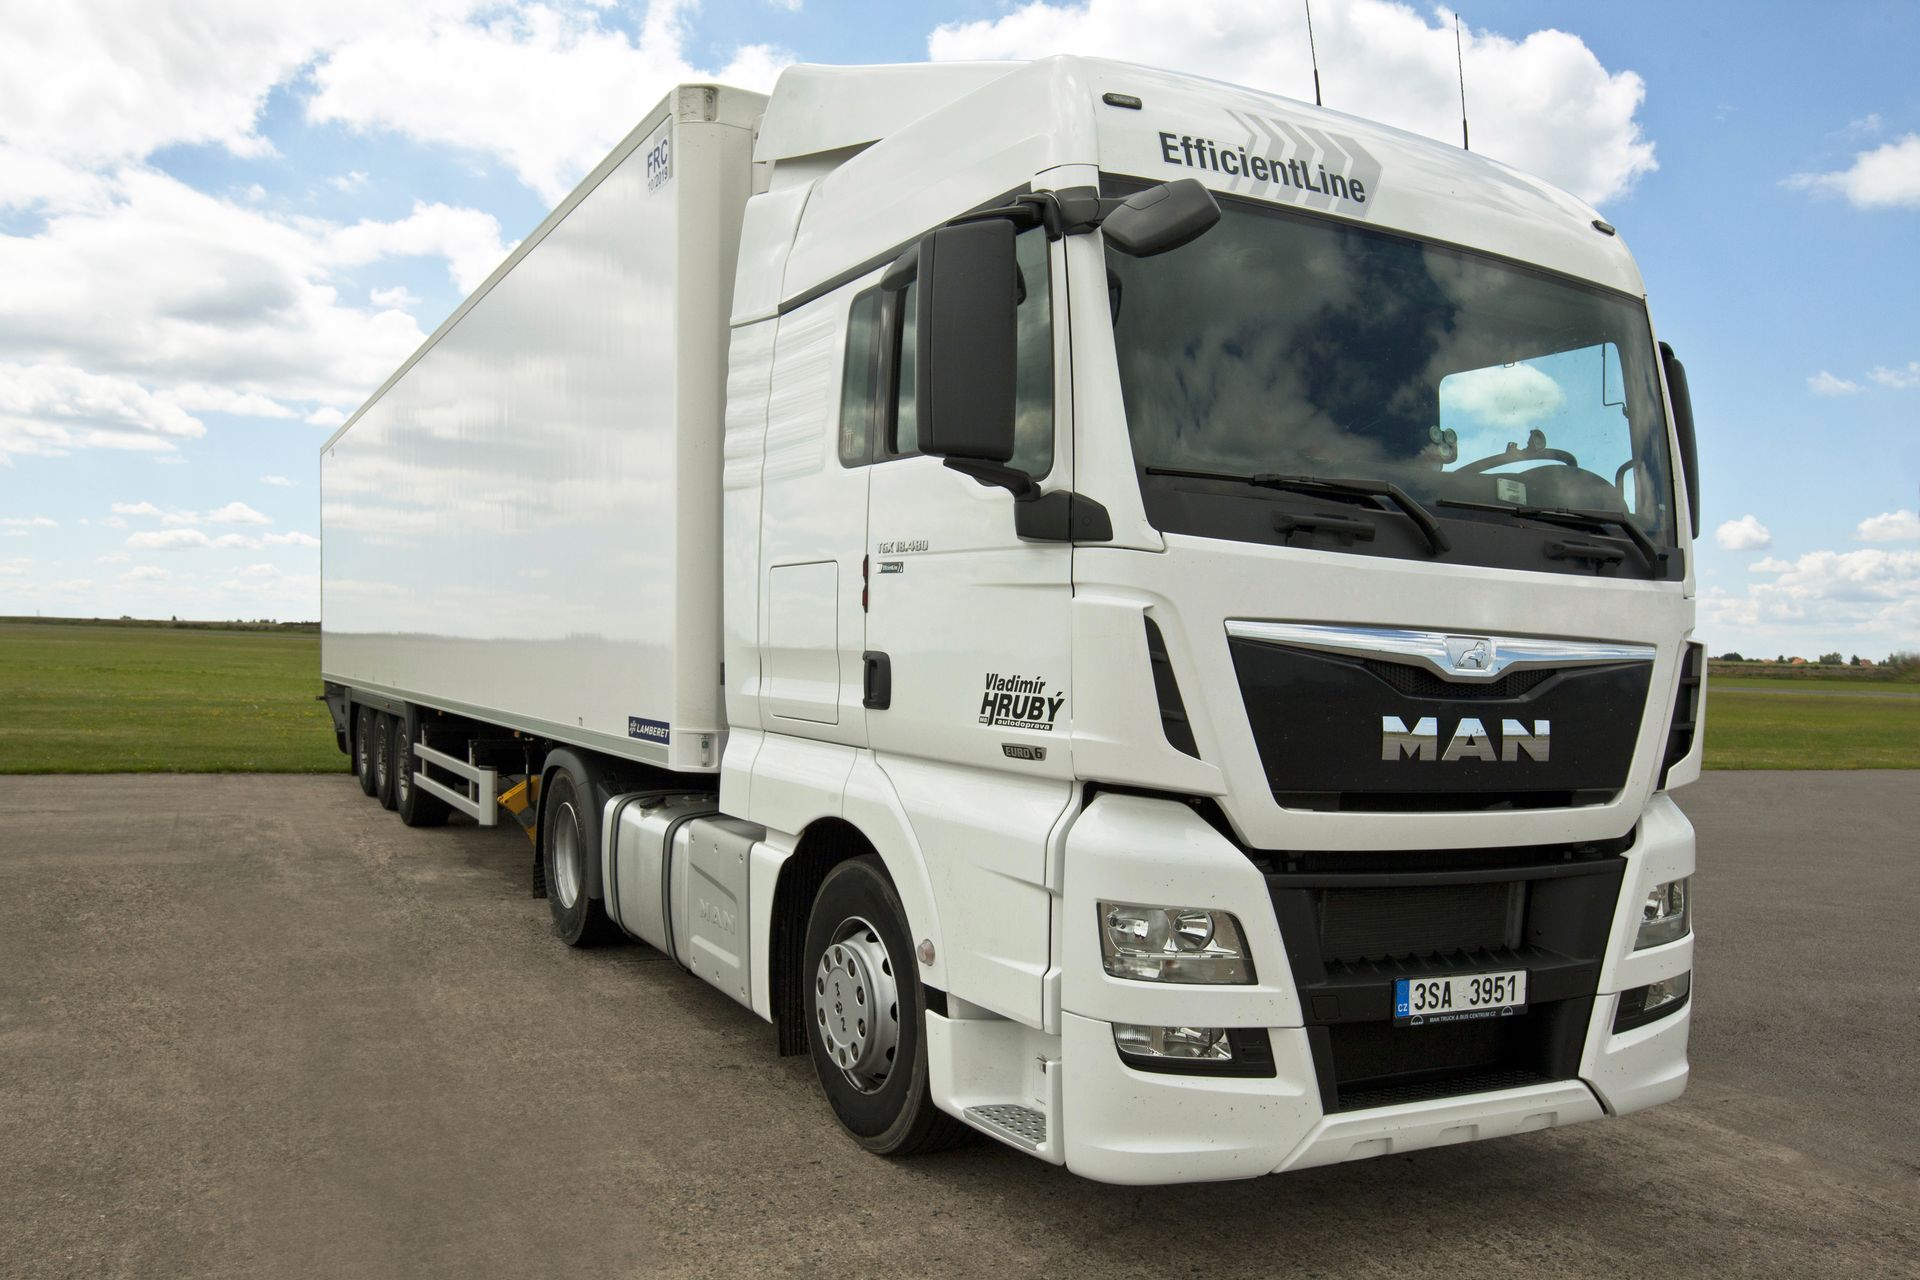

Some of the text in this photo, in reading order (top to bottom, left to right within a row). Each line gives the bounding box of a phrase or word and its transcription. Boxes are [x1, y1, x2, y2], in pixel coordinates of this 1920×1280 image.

[647, 139, 669, 178] FRC
[1158, 131, 1367, 203] EfficientLine
[985, 673, 1046, 695] Vladimír
[980, 691, 1065, 726] HRUBÝ
[636, 724, 669, 739] LAMBERET
[997, 719, 1050, 730] autodoprava
[1004, 746, 1043, 759] EURO 6
[1381, 716, 1551, 762] MAN
[1414, 975, 1516, 1010] 3SA 3951
[1397, 1003, 1408, 1012] CZ
